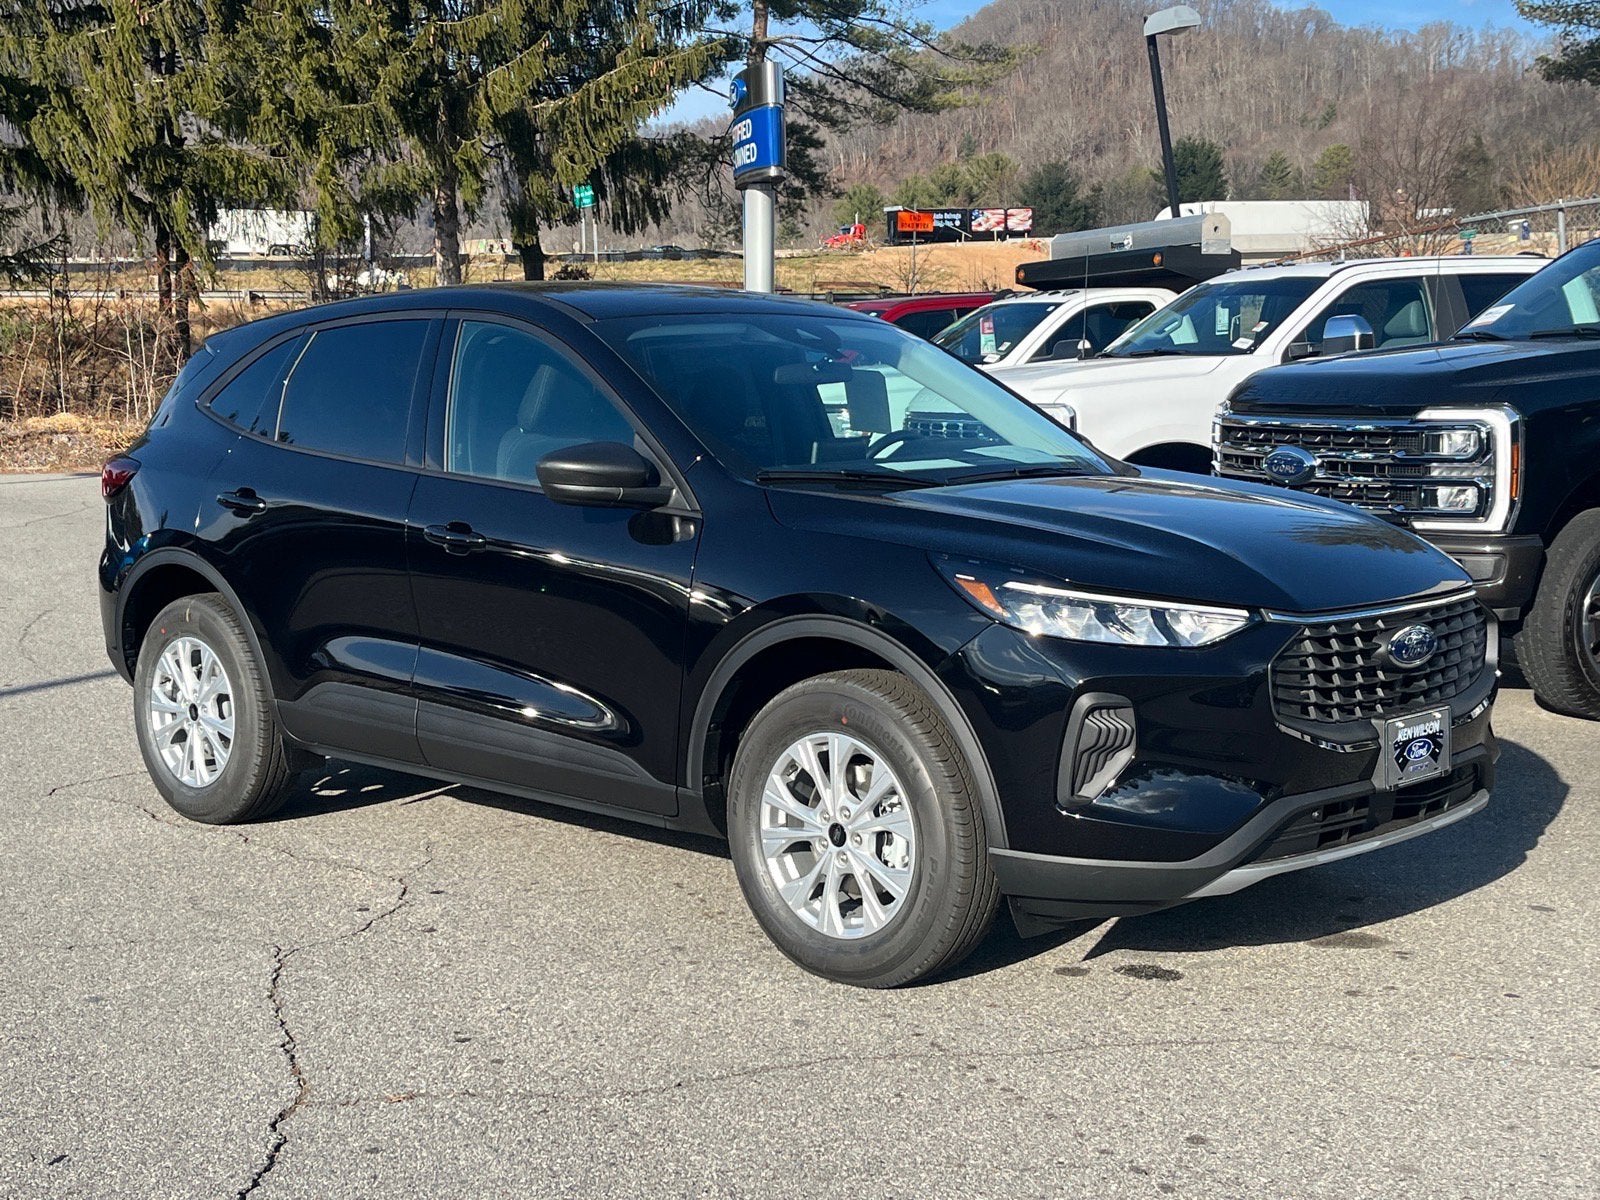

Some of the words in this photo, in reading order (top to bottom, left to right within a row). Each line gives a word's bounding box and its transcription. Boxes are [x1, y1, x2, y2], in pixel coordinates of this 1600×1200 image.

[1398, 727, 1412, 742] KEN
[1411, 719, 1441, 738] WILSON
[1410, 741, 1429, 759] Ford
